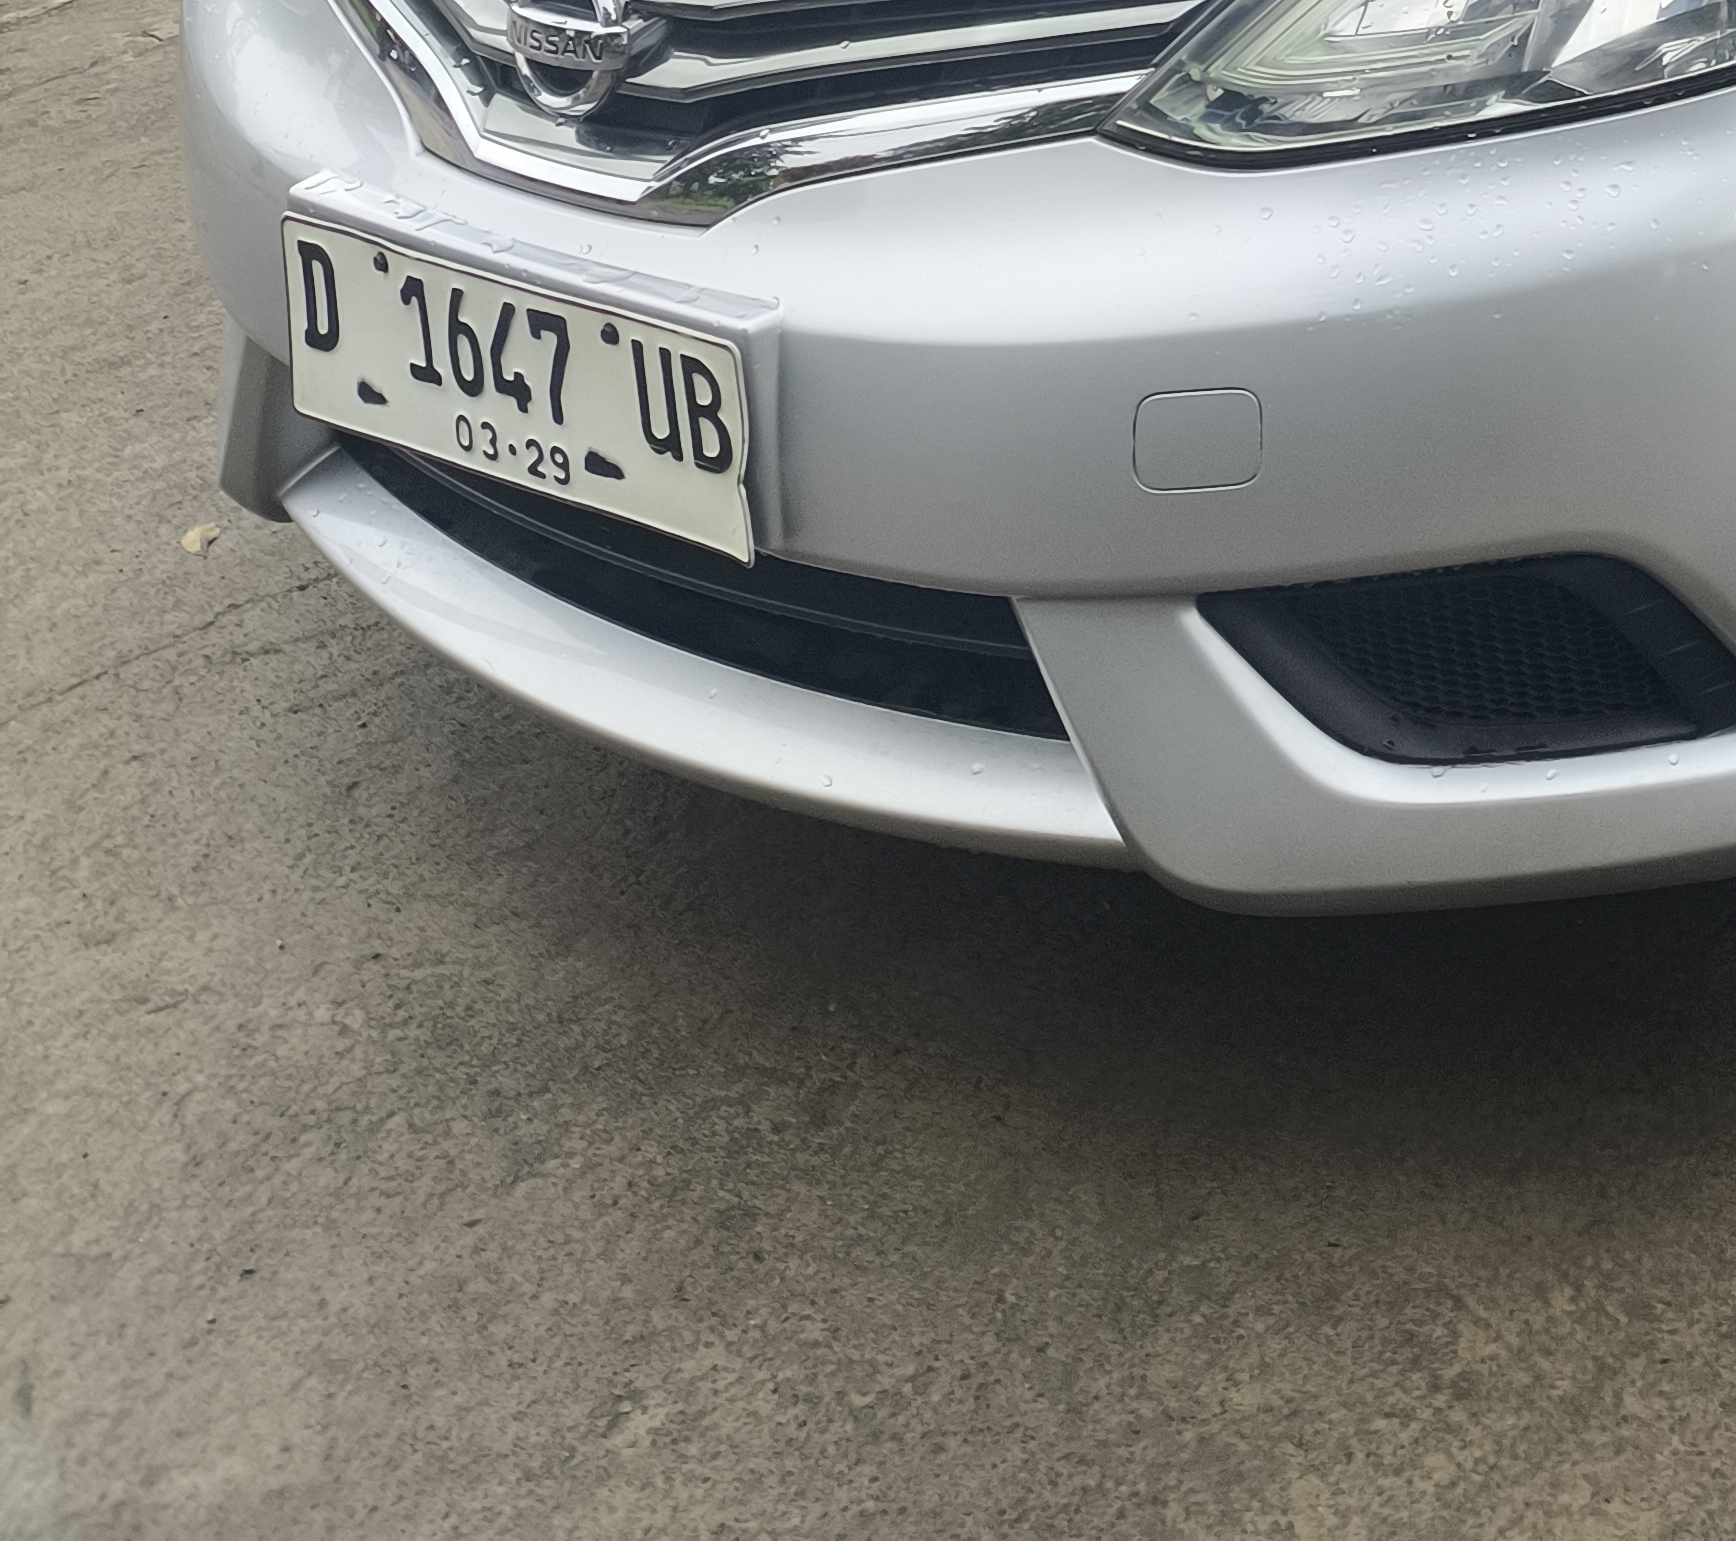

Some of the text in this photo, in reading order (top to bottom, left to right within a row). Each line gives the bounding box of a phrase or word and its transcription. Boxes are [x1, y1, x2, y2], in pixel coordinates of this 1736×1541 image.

[510, 20, 604, 61] NISSAN
[296, 239, 734, 475] D 1647 UB
